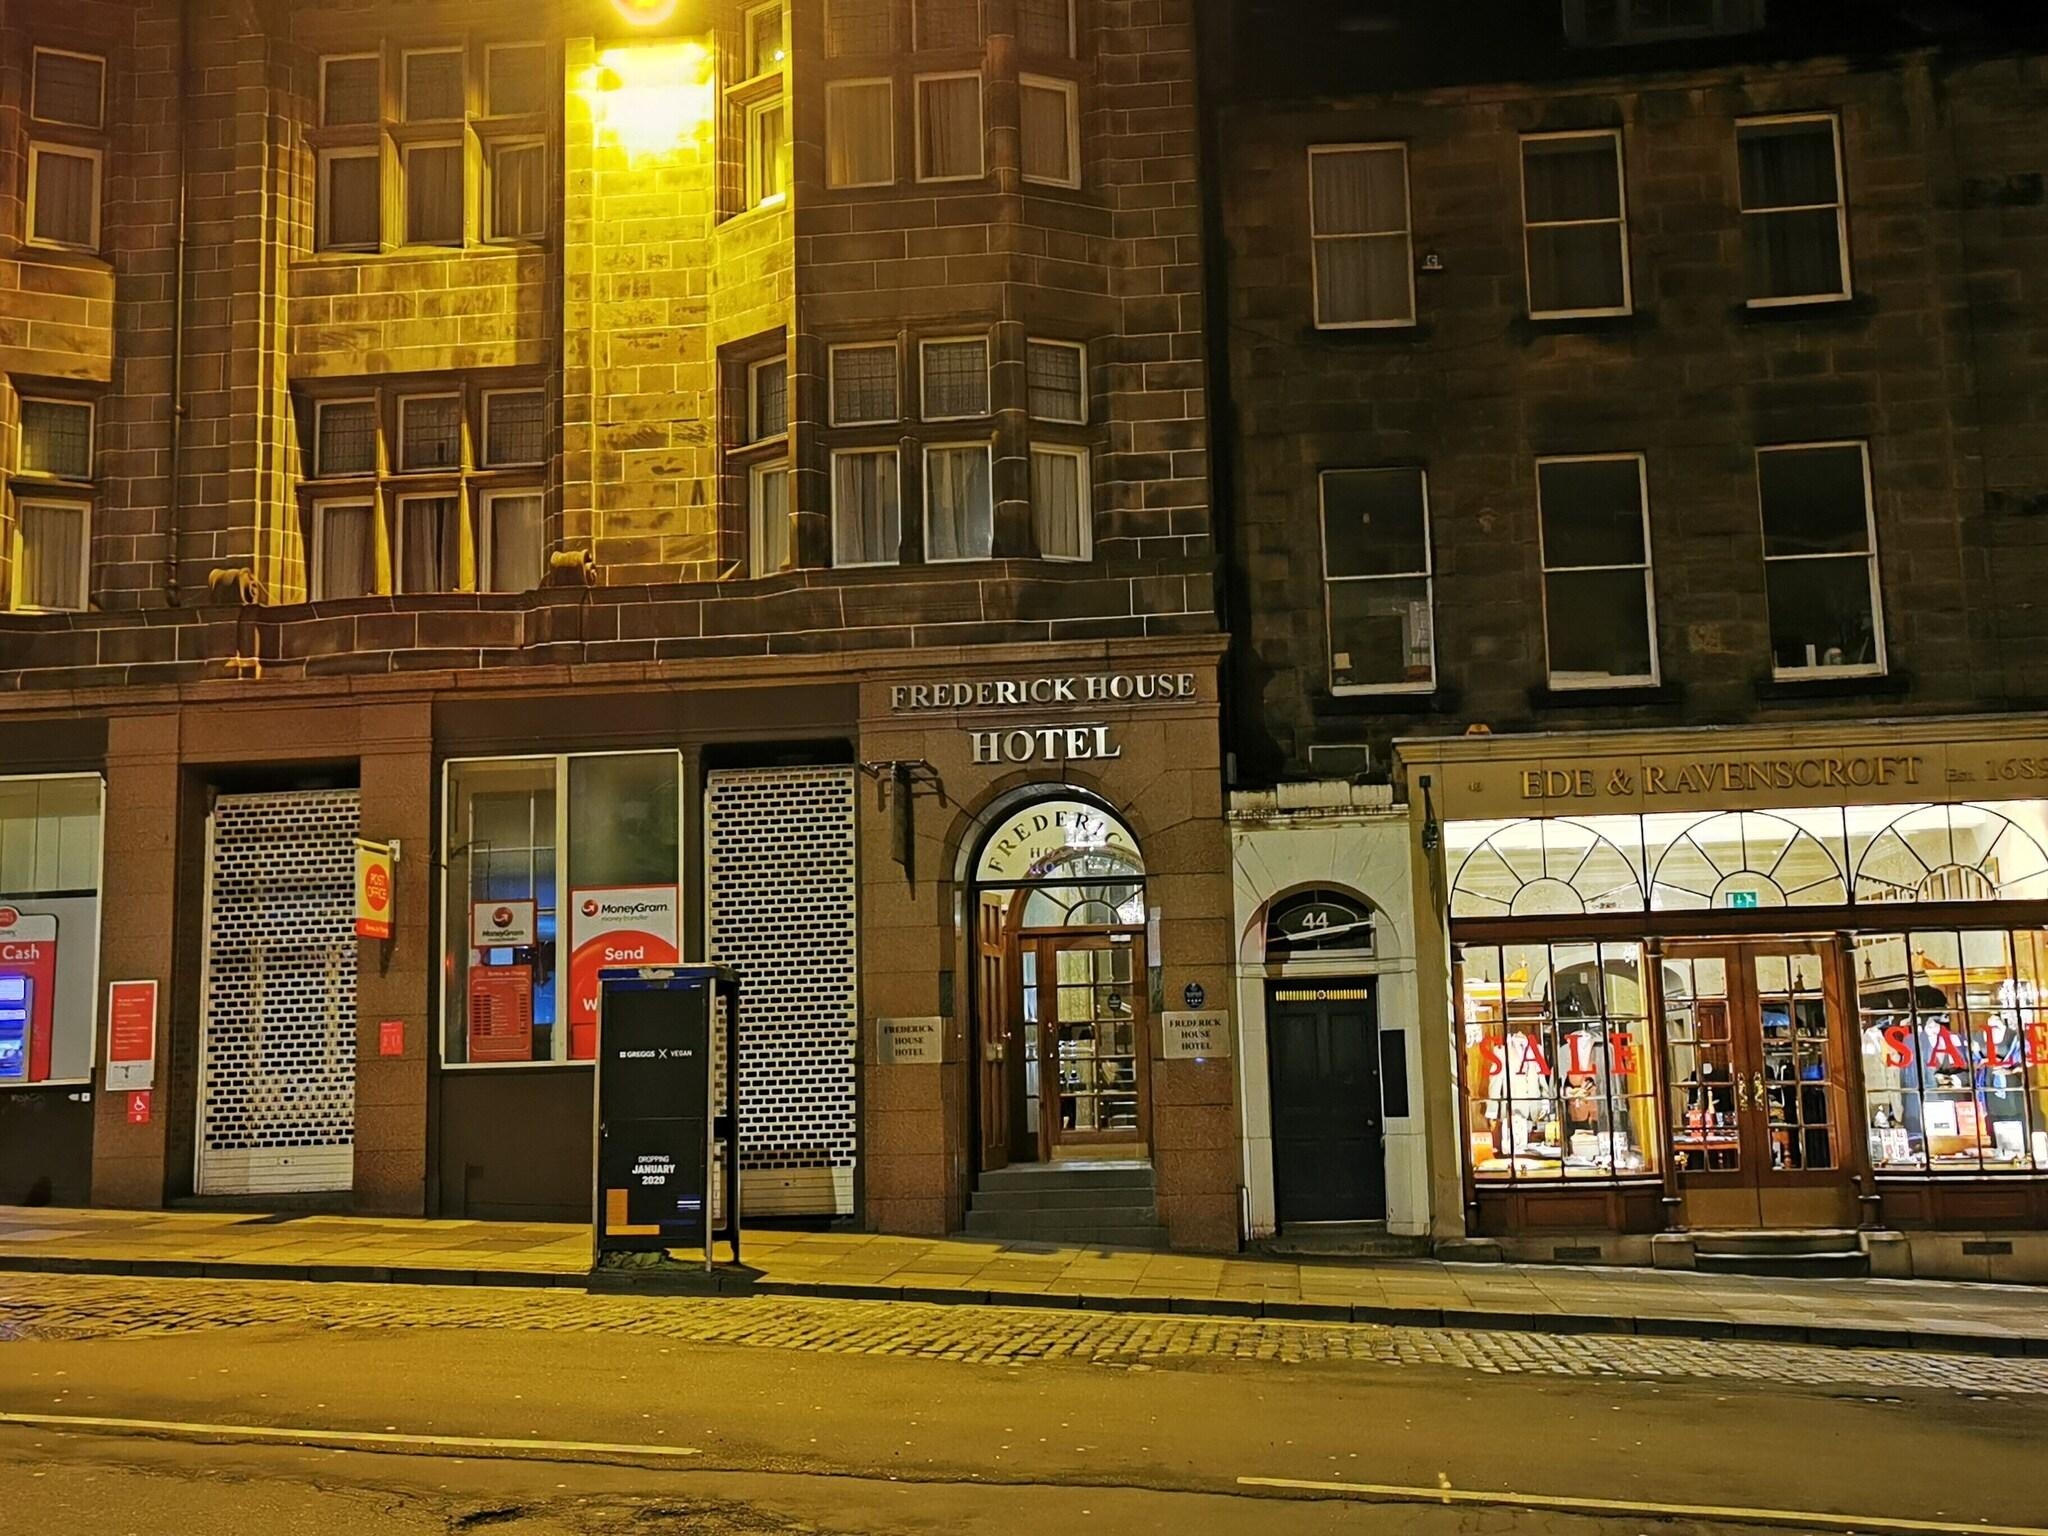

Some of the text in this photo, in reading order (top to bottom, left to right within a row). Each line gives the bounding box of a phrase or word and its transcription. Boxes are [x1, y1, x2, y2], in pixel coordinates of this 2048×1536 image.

[890, 673, 1197, 709] FREDERICK HOUSE
[970, 726, 1121, 764] HOTEL
[1520, 769, 1597, 799] EDE
[1606, 767, 1633, 796] &
[1642, 756, 1922, 795] RAVENSCROFT
[369, 873, 386, 886] POST
[601, 902, 667, 914] MoneyGram
[1302, 911, 1329, 929] 44
[2, 943, 40, 960] Cash
[604, 946, 644, 960] Send
[626, 1050, 656, 1058] GREGGS
[670, 1050, 693, 1058] VEGAN
[1479, 1031, 1637, 1077] SALE
[1883, 1023, 2048, 1070] SALE
[638, 1155, 670, 1163] DROPPING
[632, 1164, 676, 1174] JANUARY
[642, 1175, 666, 1185] 2020
